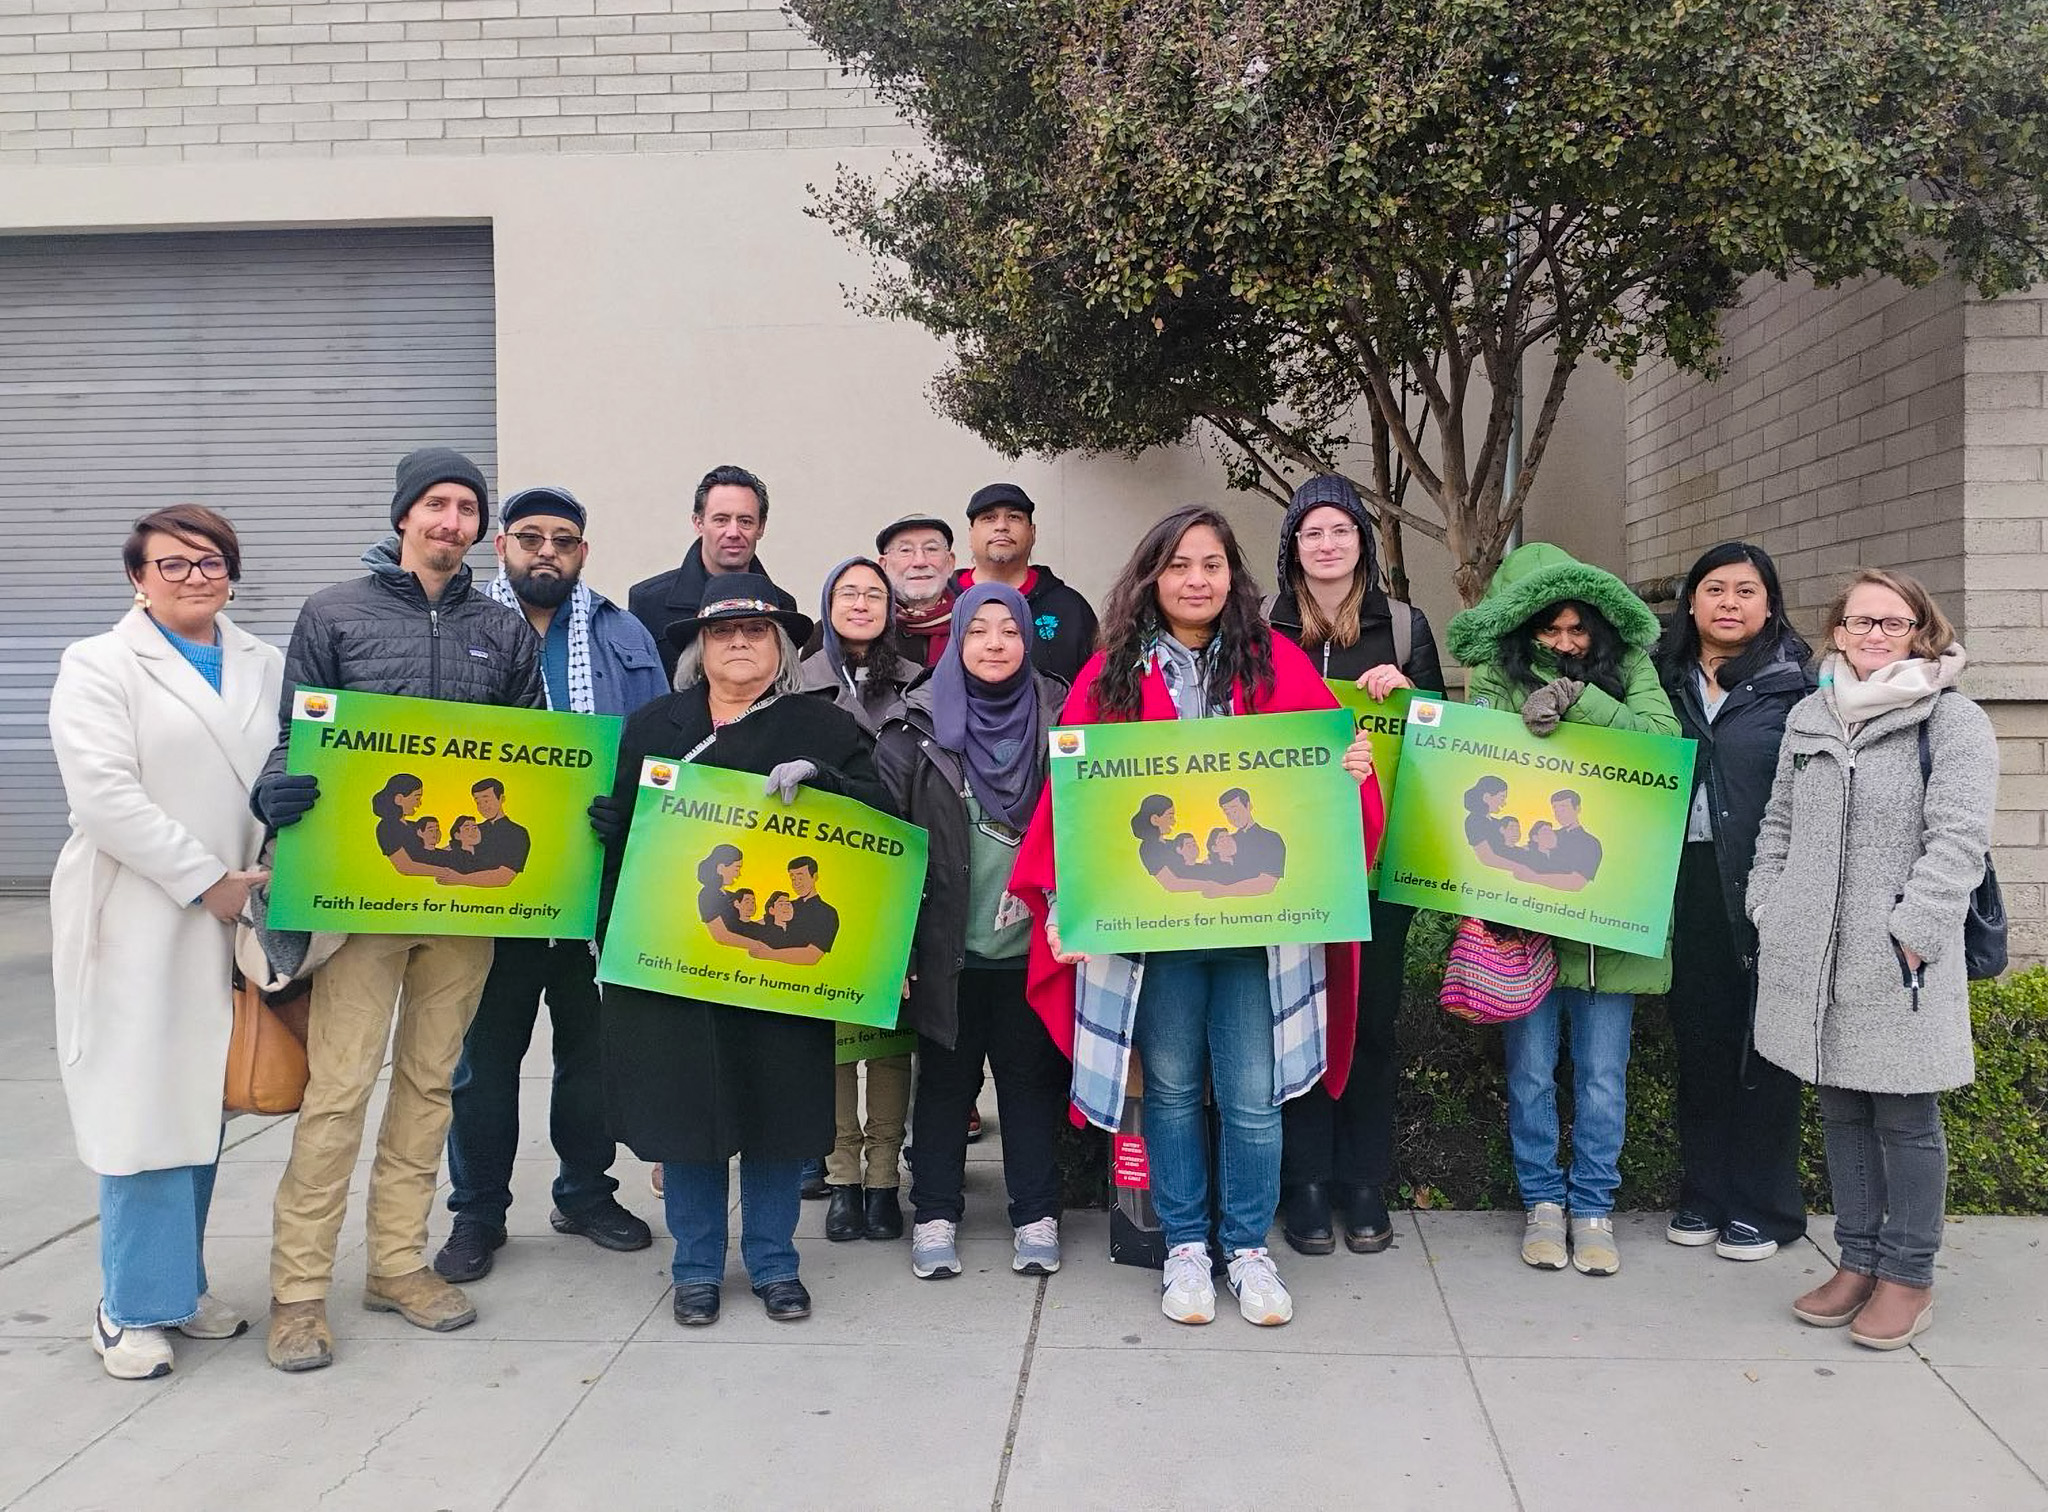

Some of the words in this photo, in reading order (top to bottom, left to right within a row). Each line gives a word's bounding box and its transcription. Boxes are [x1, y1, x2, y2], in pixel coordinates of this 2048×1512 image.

[1353, 714, 1407, 736] CRE
[320, 727, 436, 757] FAMILIES
[442, 737, 493, 761] ARE
[500, 743, 594, 769] SACRED
[1077, 756, 1180, 779] FAMILIES
[1185, 752, 1231, 774] ARE
[1237, 746, 1331, 771] SACRED
[1415, 732, 1447, 751] LAS
[1451, 738, 1530, 767] FAMILIAS
[1535, 755, 1574, 774] SON
[1579, 762, 1679, 790] SAGRADAS
[661, 795, 759, 830] FAMILIES
[763, 814, 810, 838] ARE
[815, 823, 905, 857] SACRED
[312, 895, 354, 911] Faith
[359, 896, 419, 912] leaders
[423, 898, 446, 912] for
[450, 900, 504, 915] human
[509, 902, 561, 919] dignity
[1096, 918, 1132, 932] Faith
[1136, 914, 1190, 931] leaders
[1194, 913, 1216, 927] for
[1220, 910, 1273, 925] human
[1277, 908, 1330, 924] dignity
[1393, 871, 1437, 890] Líderes
[1441, 878, 1457, 892] de
[1460, 882, 1474, 895] fe
[1477, 886, 1503, 902] por
[1505, 891, 1518, 905] la
[1522, 896, 1586, 922] dignidad
[1589, 910, 1650, 934] humana
[637, 952, 672, 970] Faith
[676, 958, 730, 983] leaders
[734, 969, 757, 986] for
[760, 974, 810, 994] human
[814, 983, 865, 1005] dignity
[858, 1031, 877, 1042] for
